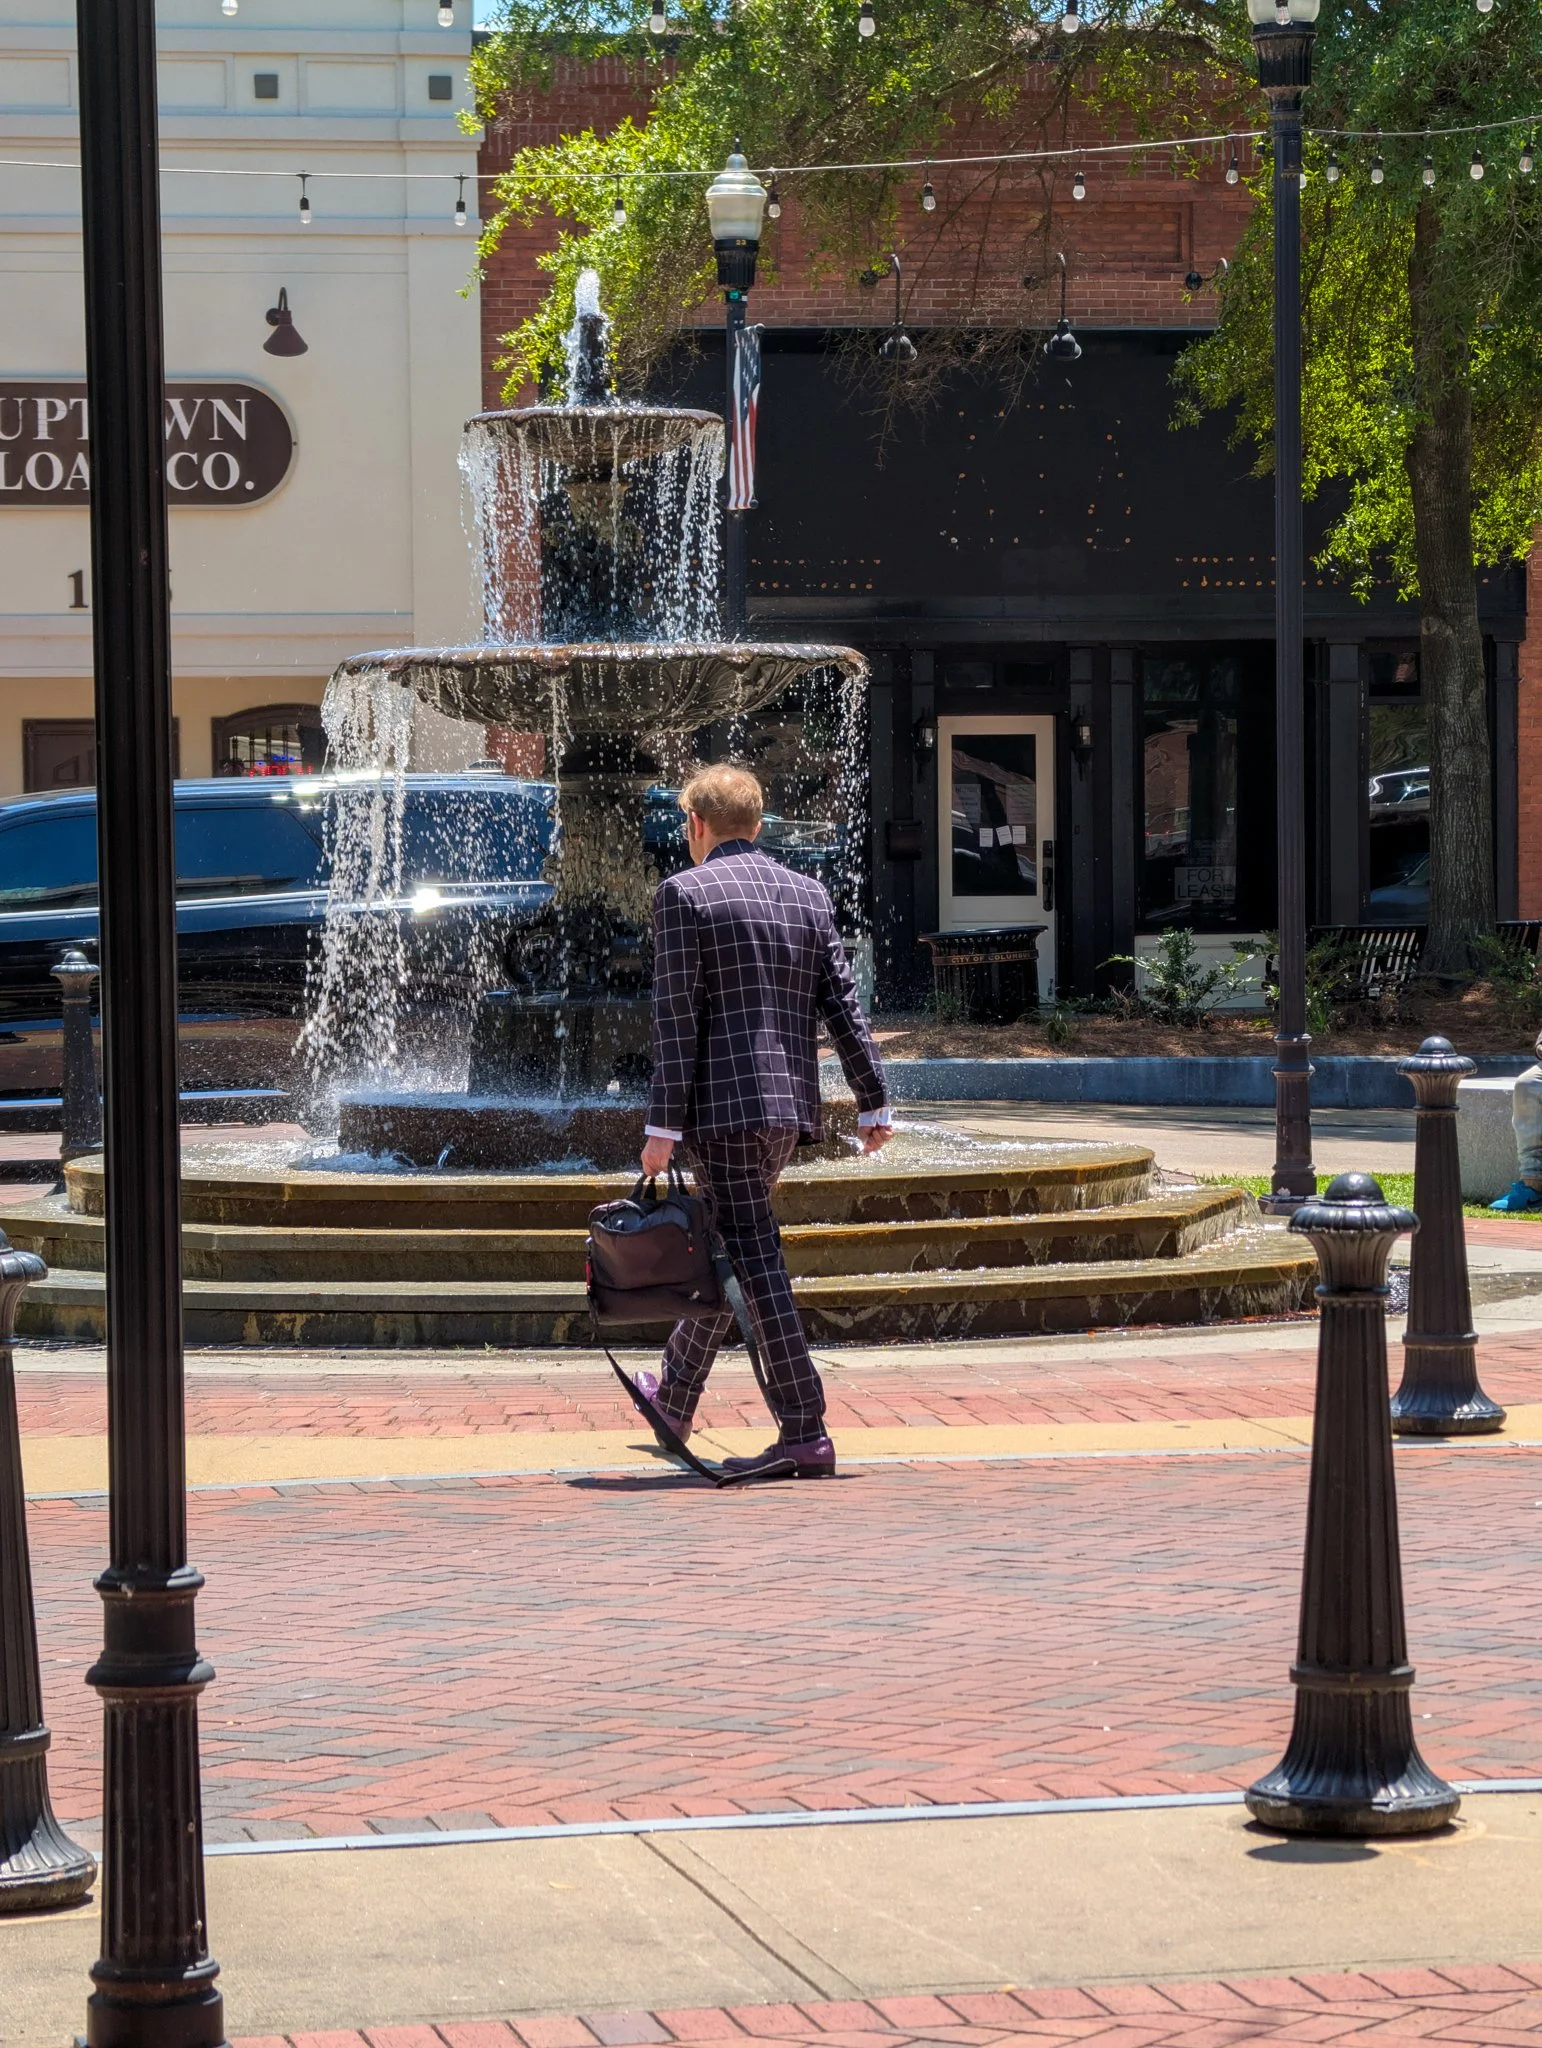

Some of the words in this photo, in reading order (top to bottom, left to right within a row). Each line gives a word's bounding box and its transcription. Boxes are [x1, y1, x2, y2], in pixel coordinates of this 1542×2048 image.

[0, 397, 250, 440] UPTWN
[0, 452, 90, 491] LOA
[166, 451, 255, 490] CO.
[1187, 868, 1225, 883] FOR
[1178, 884, 1234, 898] LEASE
[951, 955, 971, 964] CITY
[973, 954, 984, 962] OF
